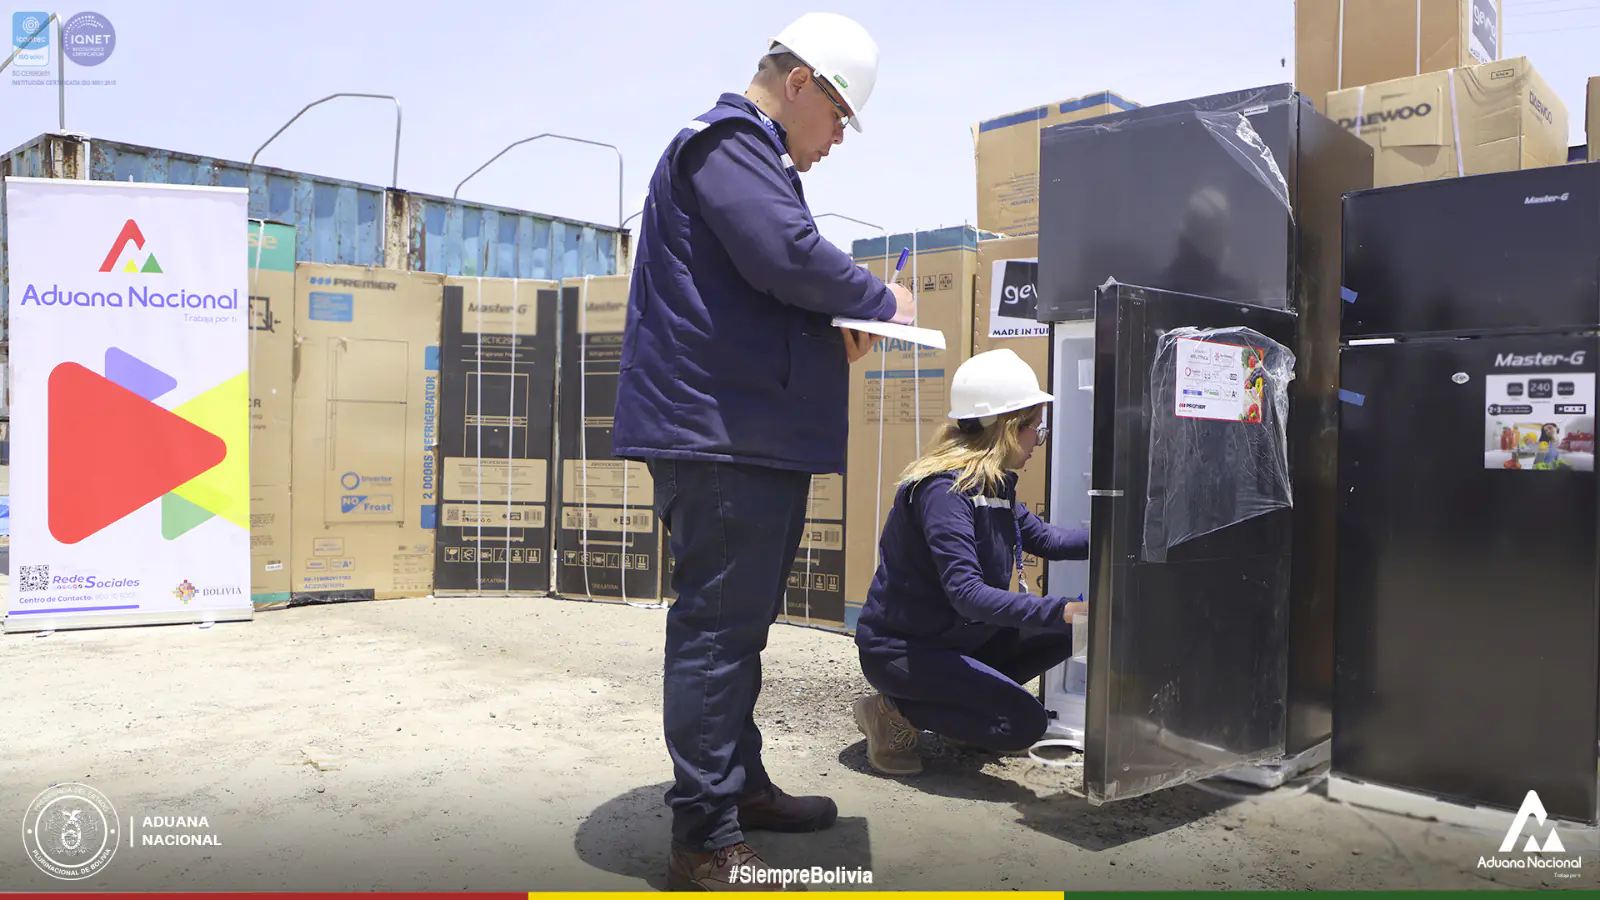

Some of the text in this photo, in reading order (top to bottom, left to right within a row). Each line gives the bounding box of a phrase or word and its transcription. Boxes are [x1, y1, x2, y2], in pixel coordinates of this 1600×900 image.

[1529, 90, 1553, 125] DAEWOO
[1338, 103, 1432, 130] DAEWOO
[1524, 192, 1570, 205] Master-G
[333, 277, 398, 291] PREMIER
[20, 284, 238, 310] Aduana Nacional
[467, 302, 528, 314] Master-G
[215, 316, 229, 324] por
[992, 328, 1019, 336] MADE
[1494, 351, 1586, 367] Master-G
[1530, 382, 1550, 392] 240
[423, 375, 436, 452] REFRIGERATOR
[422, 455, 433, 489] DOORS
[343, 497, 360, 505] NO
[363, 502, 392, 512] Frost
[202, 587, 242, 597] BOLIVIA
